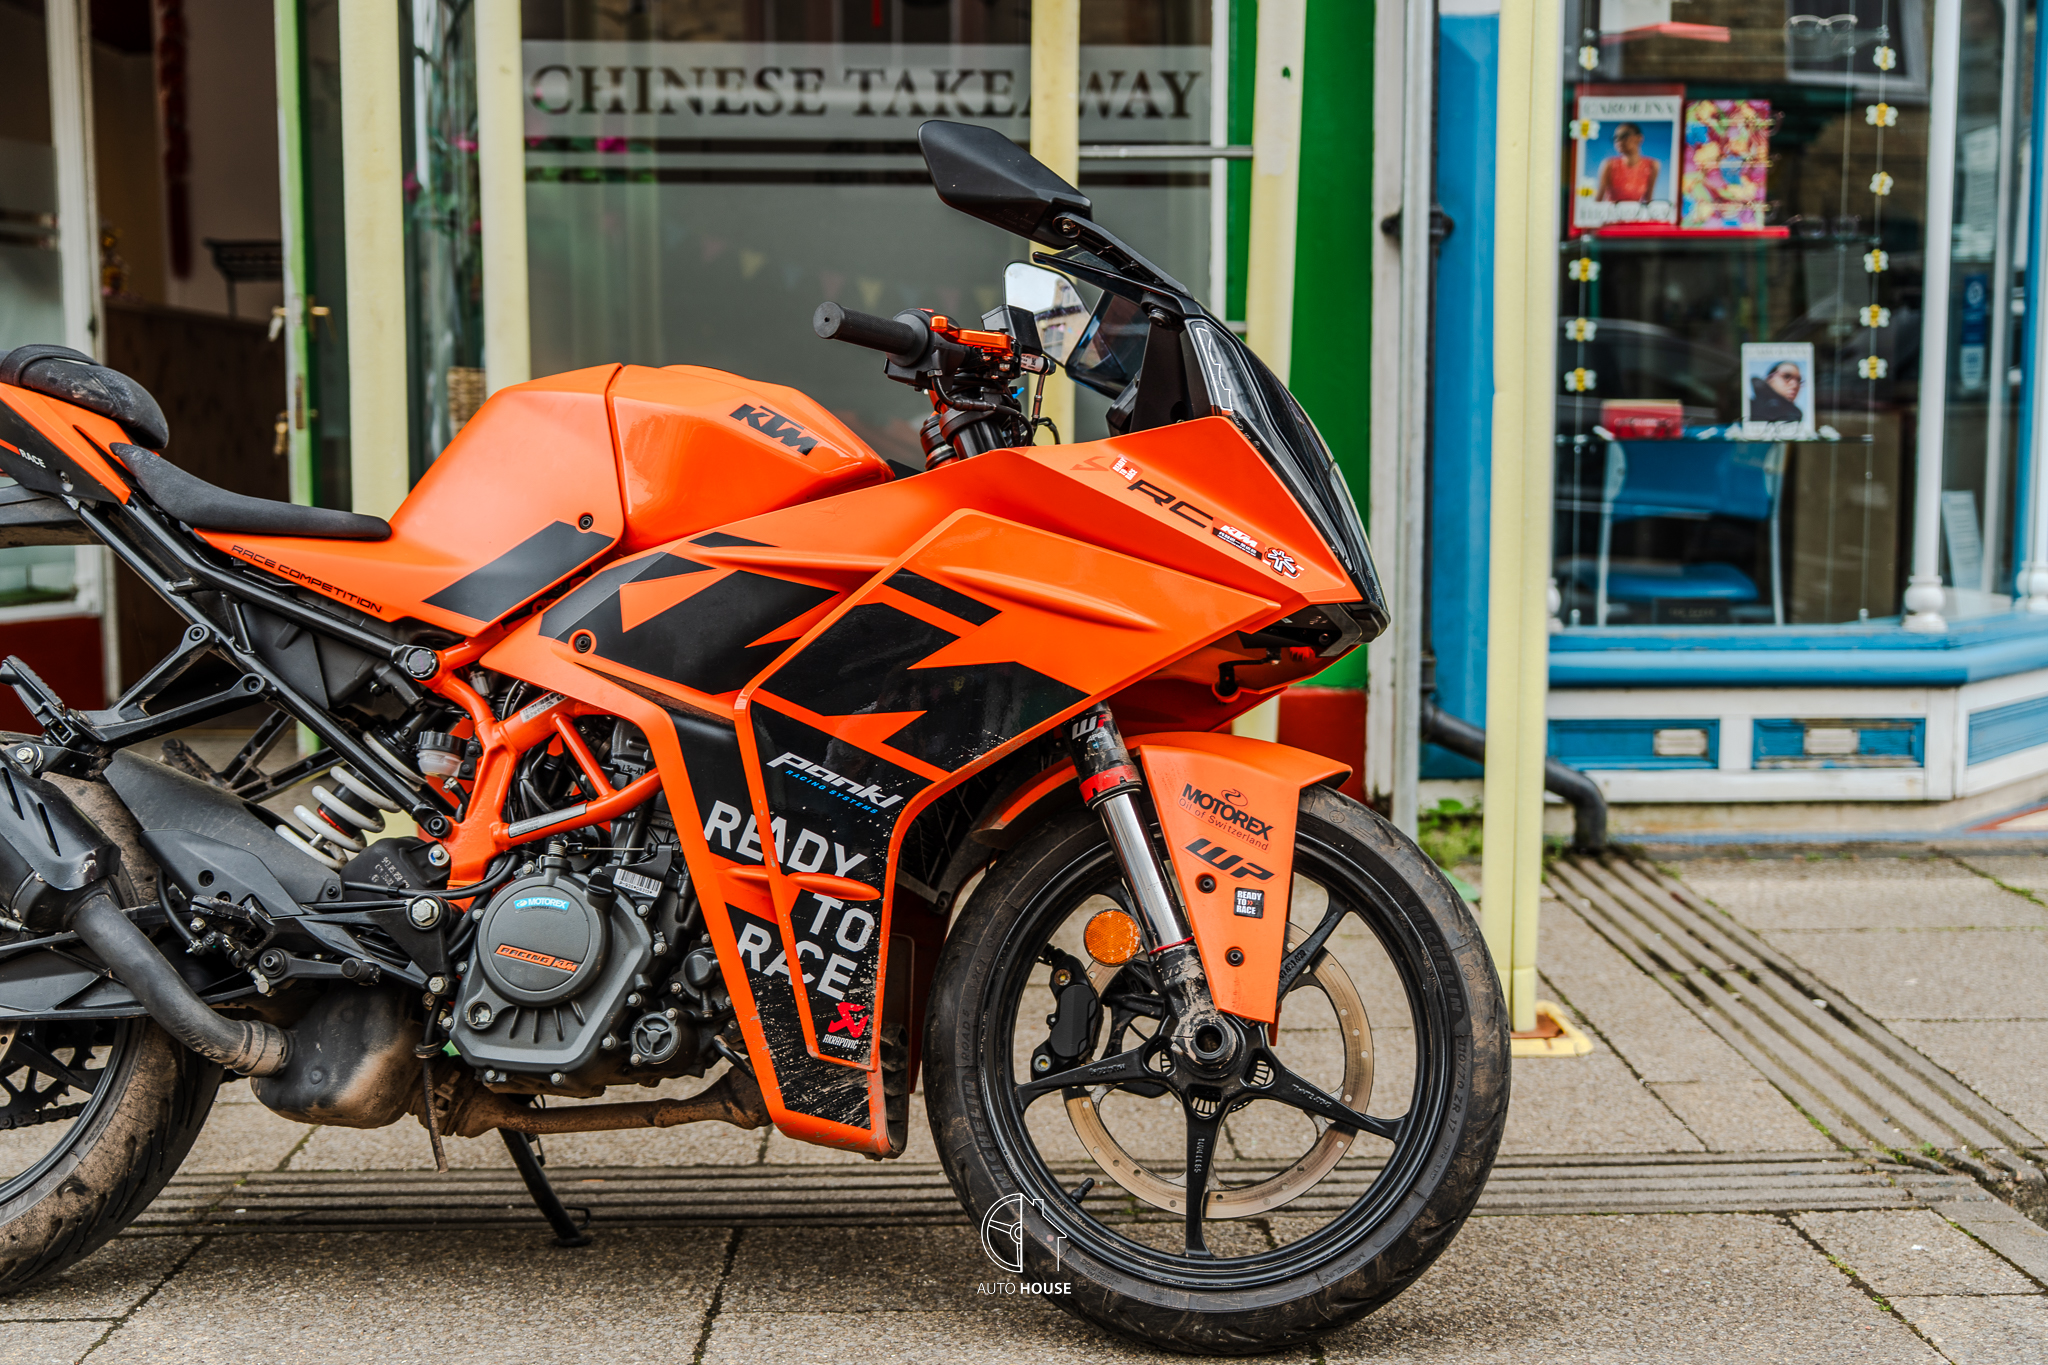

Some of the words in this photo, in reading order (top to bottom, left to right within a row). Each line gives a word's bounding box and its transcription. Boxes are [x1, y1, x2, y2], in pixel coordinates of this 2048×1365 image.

[529, 64, 829, 116] CHINESE
[843, 67, 1203, 119] TAKEWAY
[1583, 101, 1676, 114] CAROLINA
[728, 403, 819, 456] KTM
[19, 448, 46, 468] RACE
[1127, 479, 1213, 528] RC
[1220, 525, 1258, 548] KTM
[231, 544, 277, 569] RACE
[278, 564, 383, 613] COMPETITION
[1072, 714, 1112, 740] WP
[785, 769, 827, 790] RACING
[828, 790, 879, 814] SYSTEMS
[1182, 783, 1274, 841] MOTOREX
[703, 800, 868, 878] READY
[1178, 798, 1193, 811] Oil
[1194, 810, 1206, 819] of
[1207, 815, 1269, 851] Switzerland
[1185, 838, 1275, 880] WP
[528, 898, 567, 909] MOTOREX
[1236, 905, 1256, 915] RACE
[1237, 890, 1263, 901] READY
[809, 892, 875, 952] TO
[500, 947, 551, 964] RACING
[552, 959, 578, 972] KTM
[737, 922, 858, 1000] RACE
[1408, 905, 1463, 1012] MICHELIN
[961, 1020, 972, 1062] ROAD
[1457, 1041, 1467, 1089] 110/70
[1448, 1118, 1458, 1134] 17
[1452, 1095, 1463, 1113] ZR
[962, 1081, 1009, 1189] MICHELIN
